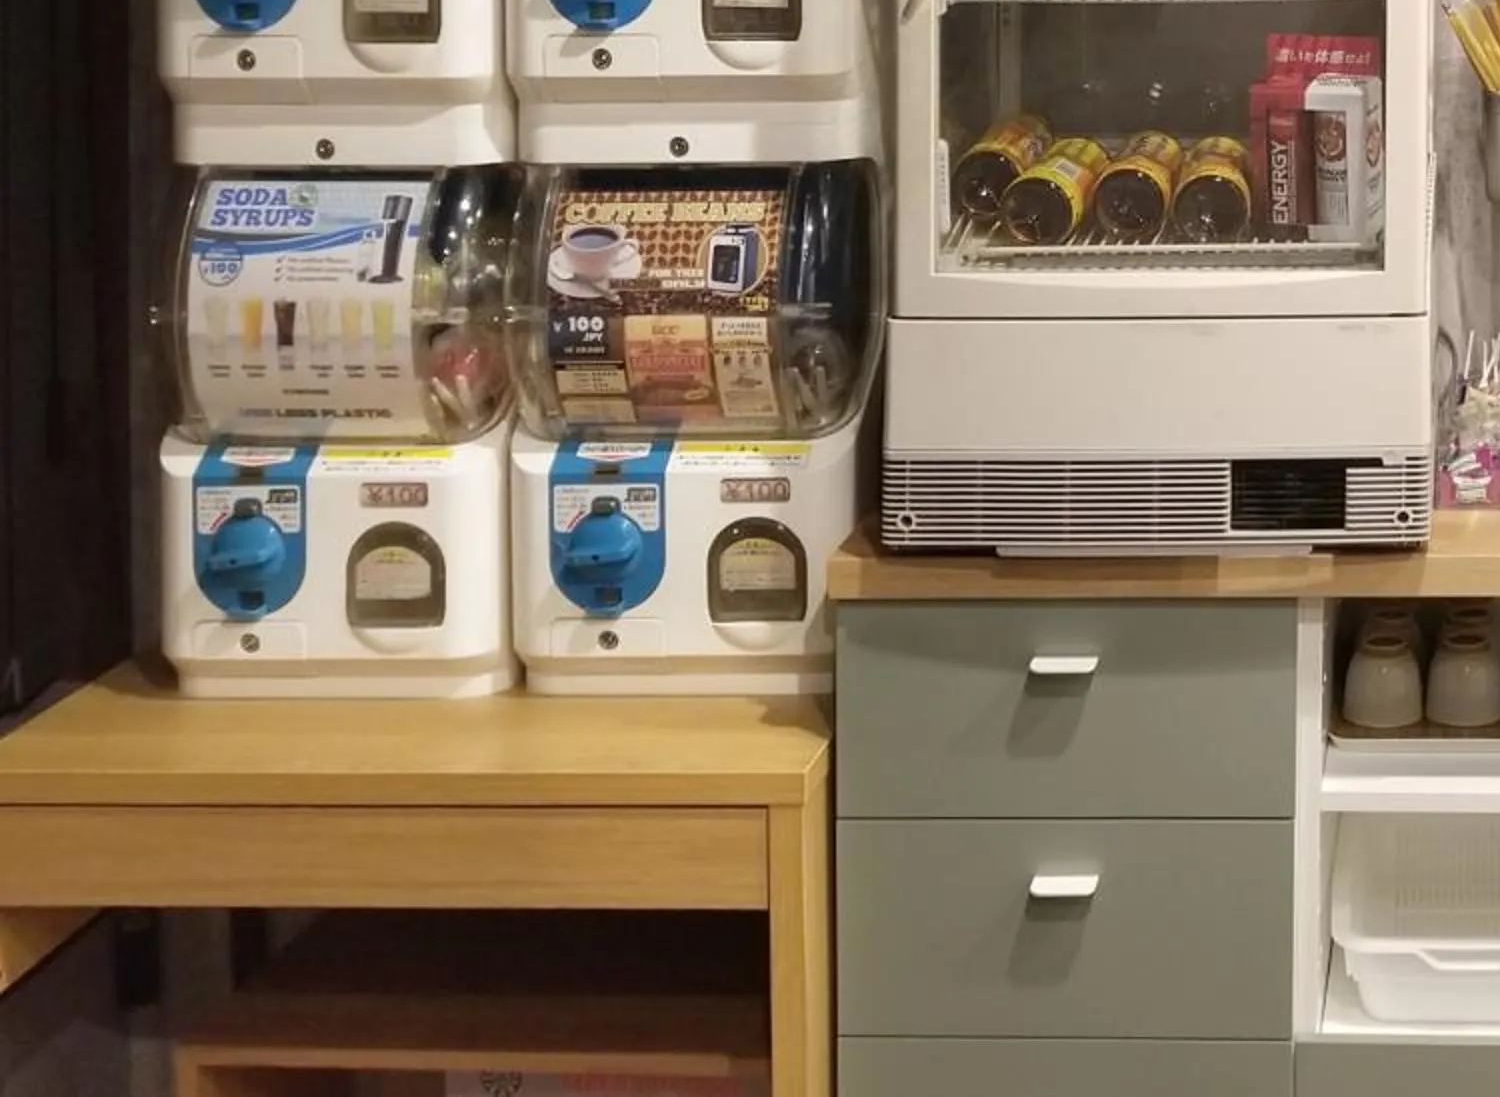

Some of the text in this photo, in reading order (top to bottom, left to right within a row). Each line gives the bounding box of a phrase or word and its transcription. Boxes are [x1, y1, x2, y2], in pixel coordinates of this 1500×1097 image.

[1270, 139, 1290, 225] ENERGY
[216, 188, 289, 206] SODA
[210, 208, 316, 227] SYRUPS
[567, 316, 605, 332] 100
[321, 409, 393, 418] PLASTIC
